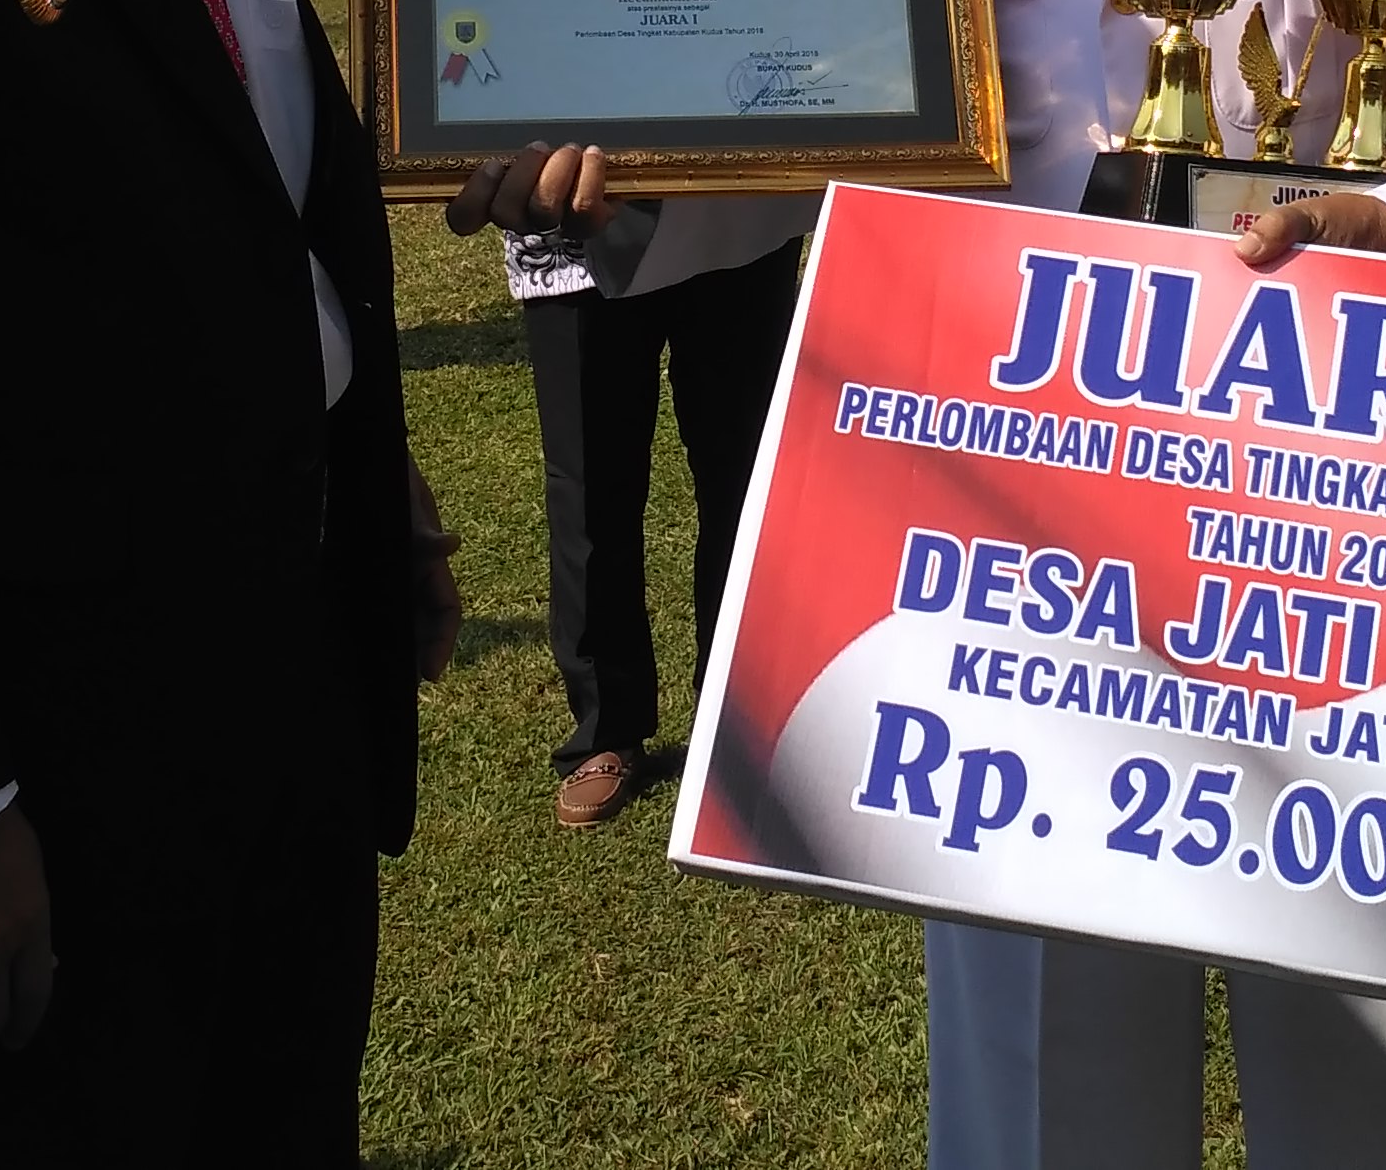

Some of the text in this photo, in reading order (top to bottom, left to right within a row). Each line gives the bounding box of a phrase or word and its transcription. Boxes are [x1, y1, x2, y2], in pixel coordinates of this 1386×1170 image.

[637, 30, 662, 38] Tingkat
[663, 29, 700, 37] Kabupaten
[640, 14, 698, 26] JUARA I
[838, 386, 1115, 471] PERLOMBAAN
[1126, 435, 1231, 490] DESA
[1189, 510, 1329, 577] TAHUN
[899, 533, 1136, 647] DESA
[1168, 580, 1376, 687] JATI
[948, 643, 1293, 748] KECAMATAN
[857, 701, 1054, 853] Rp.
